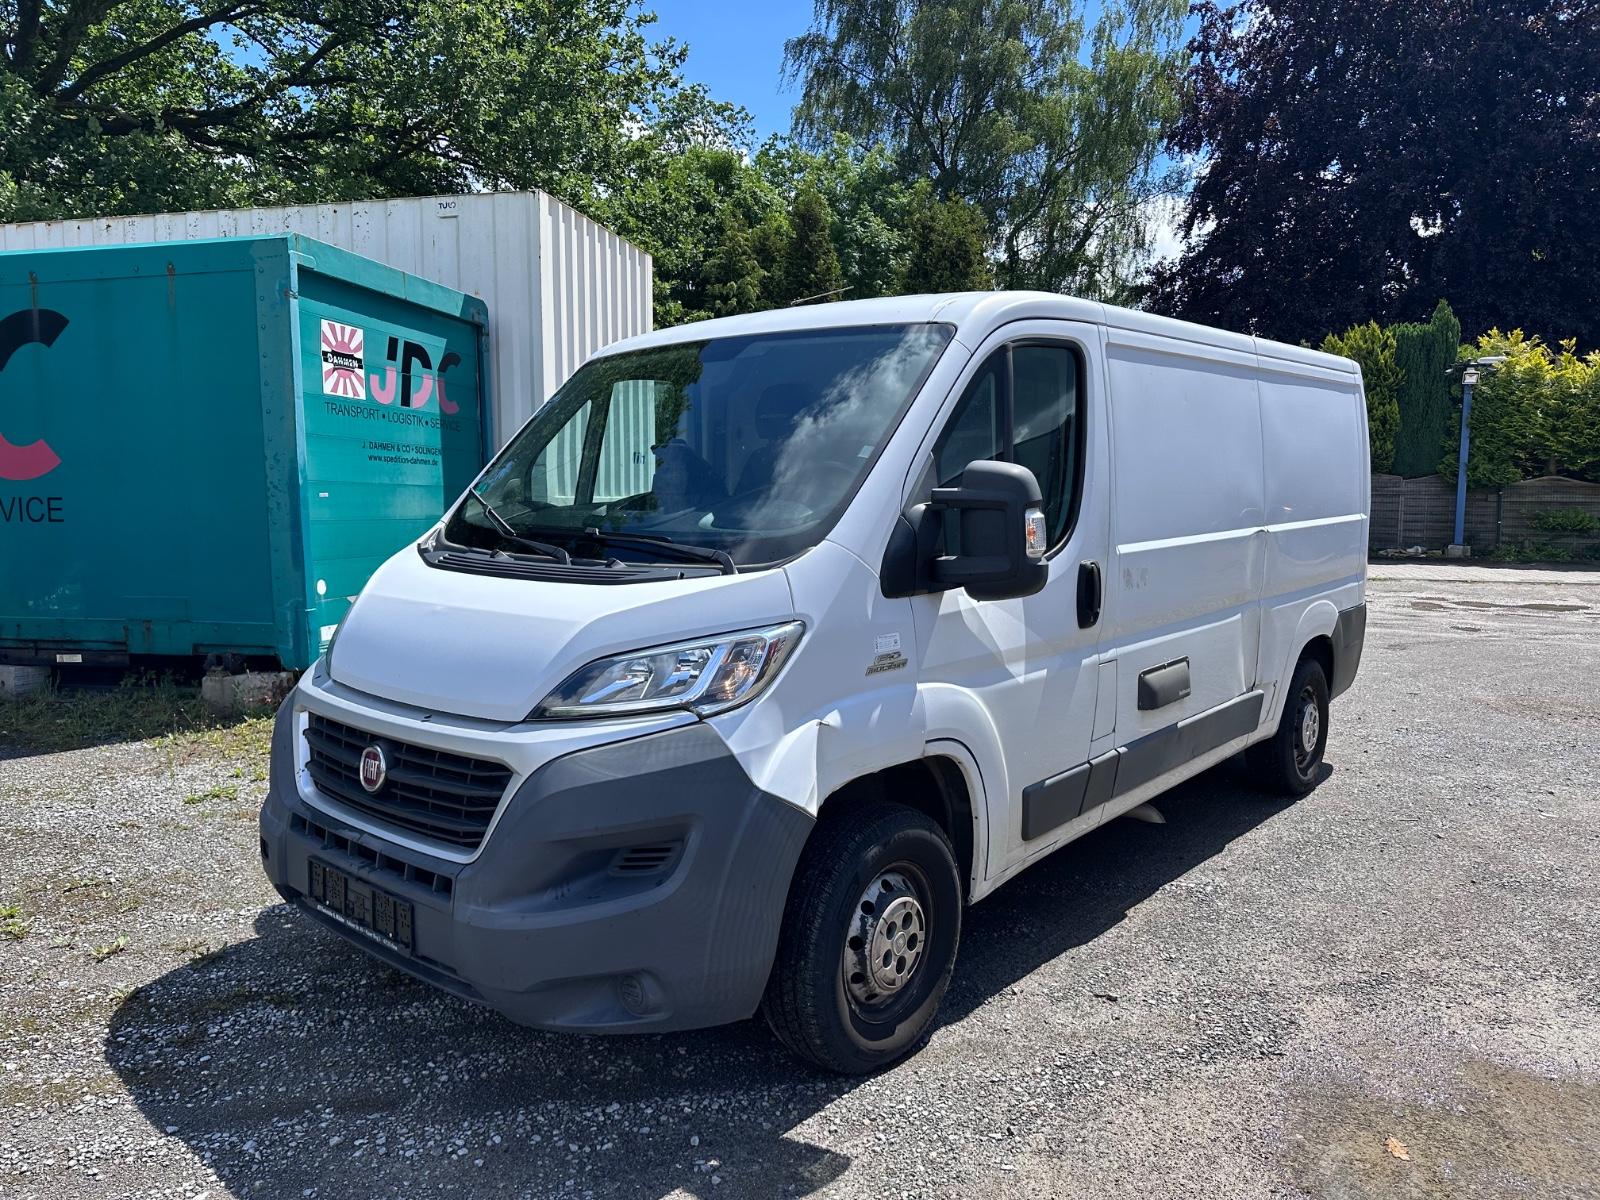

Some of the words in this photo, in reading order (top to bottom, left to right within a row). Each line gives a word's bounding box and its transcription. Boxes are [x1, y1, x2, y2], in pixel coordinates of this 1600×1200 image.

[327, 353, 359, 368] DAHMEN
[369, 336, 462, 415] JDC
[324, 402, 381, 421] TRANSPORT
[387, 411, 425, 427] LOGISTIK
[430, 418, 461, 433] SERVICE
[368, 441, 396, 453] DAHMEN
[396, 444, 401, 453] &
[401, 444, 411, 454] CO
[368, 454, 438, 466] www.spedition-dahmen.de
[364, 759, 379, 781] FIAT
